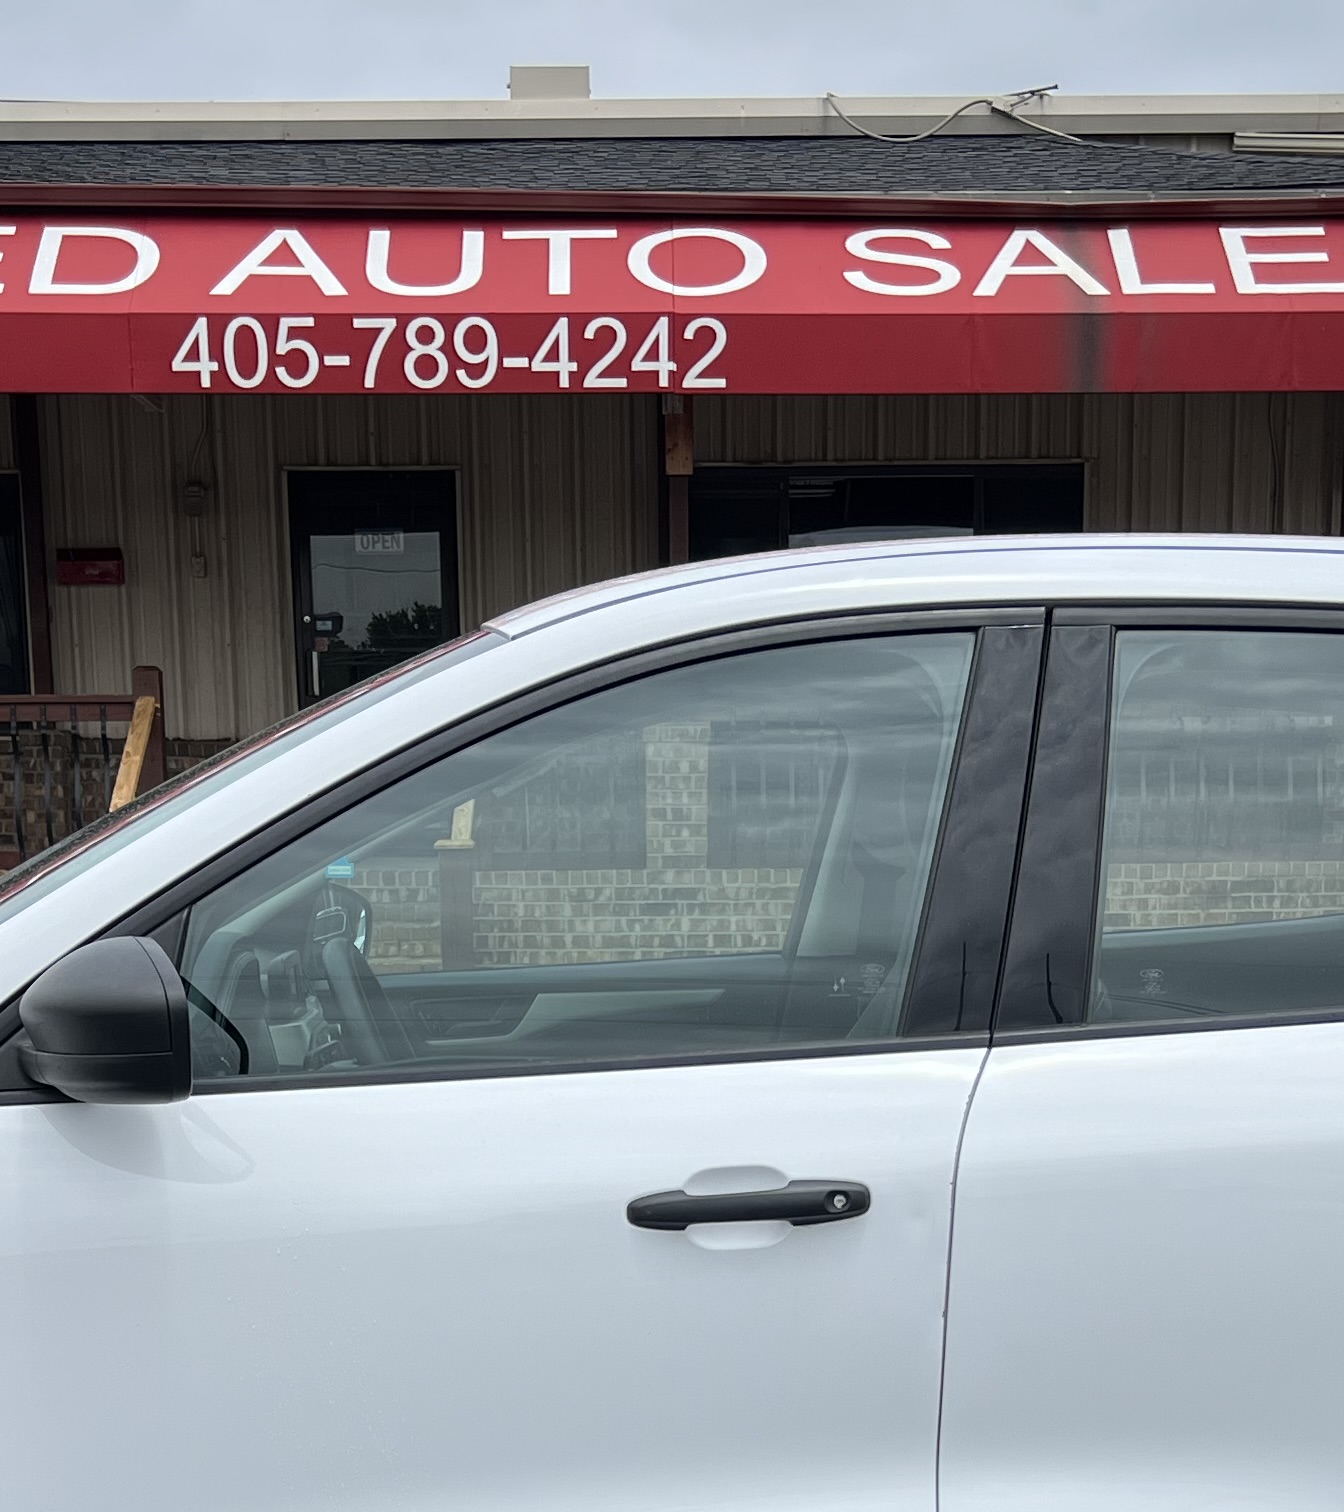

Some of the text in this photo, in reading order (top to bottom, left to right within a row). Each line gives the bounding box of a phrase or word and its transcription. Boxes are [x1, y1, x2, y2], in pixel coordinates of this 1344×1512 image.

[209, 228, 767, 296] AUTO
[172, 317, 726, 388] 405-789-4242
[360, 532, 401, 550] OPEN
